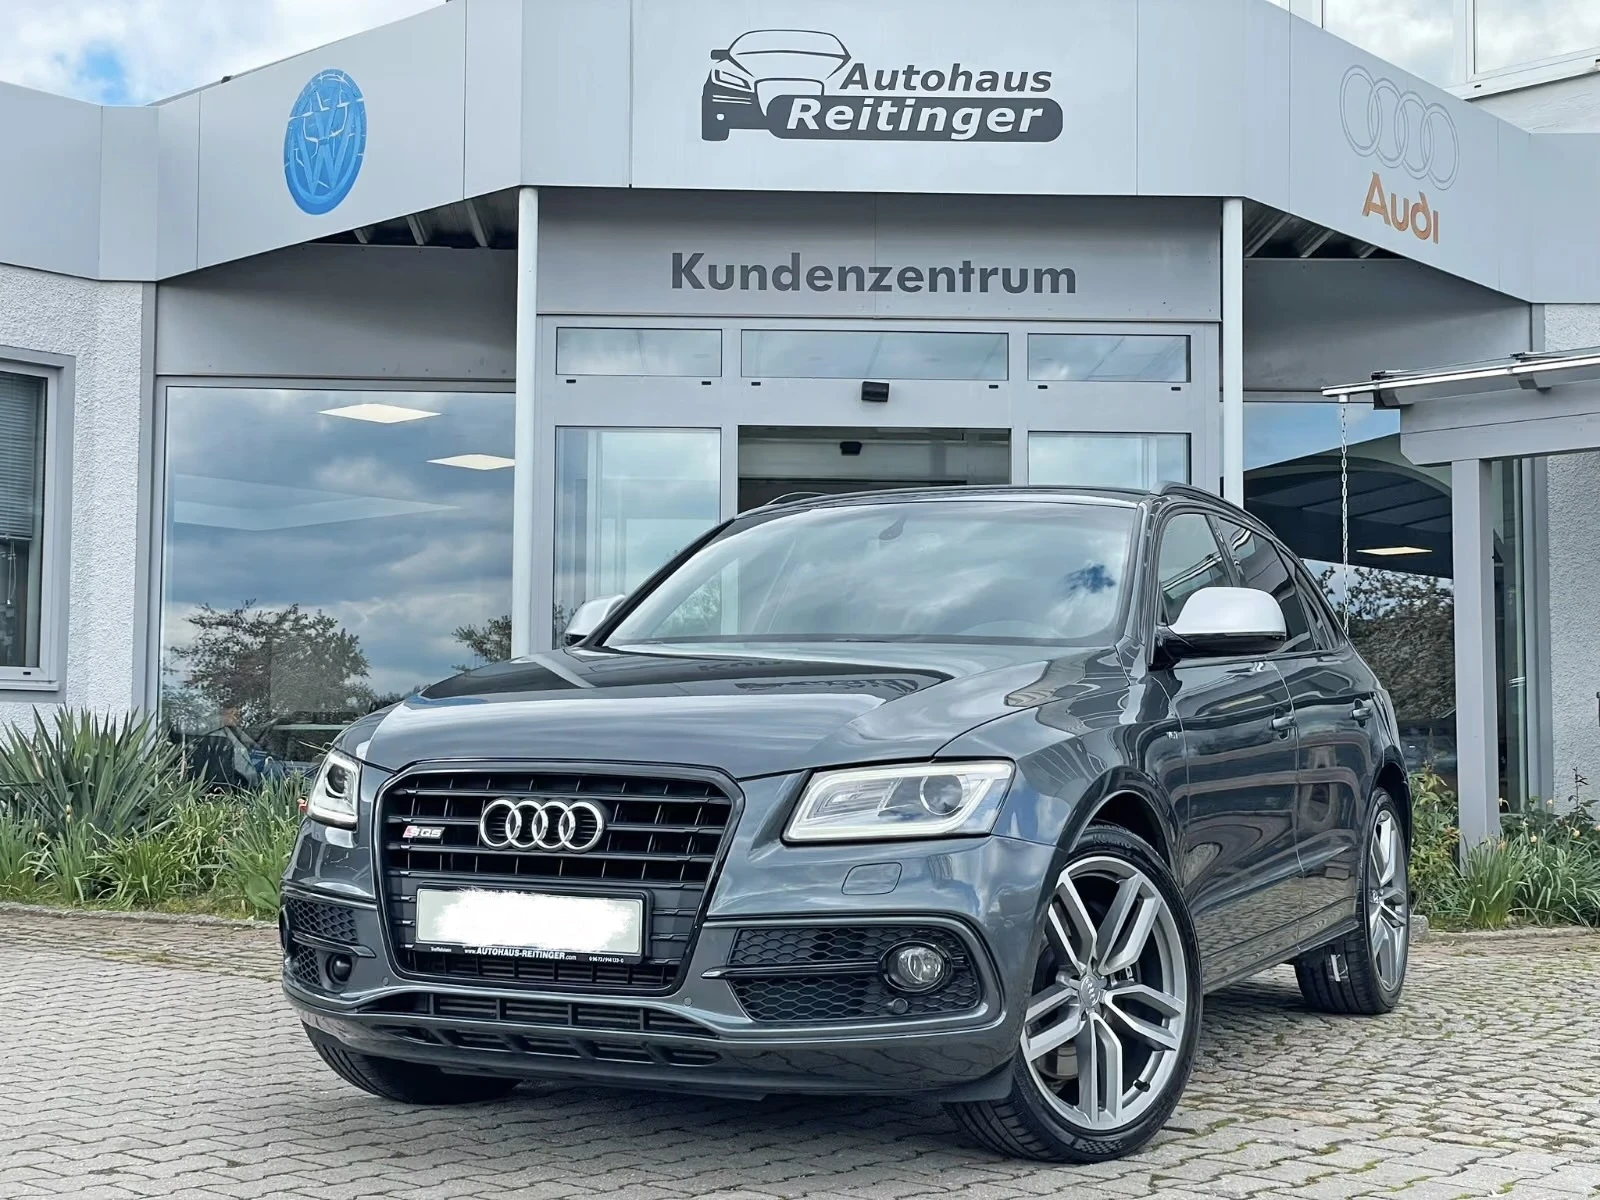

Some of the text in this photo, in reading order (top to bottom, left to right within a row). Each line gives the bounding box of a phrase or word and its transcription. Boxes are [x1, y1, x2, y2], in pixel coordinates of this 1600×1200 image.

[839, 62, 1052, 92] Autohaus
[786, 97, 1044, 140] Reitinger
[1361, 170, 1439, 244] Audi
[671, 252, 1076, 294] Kundenzentrum
